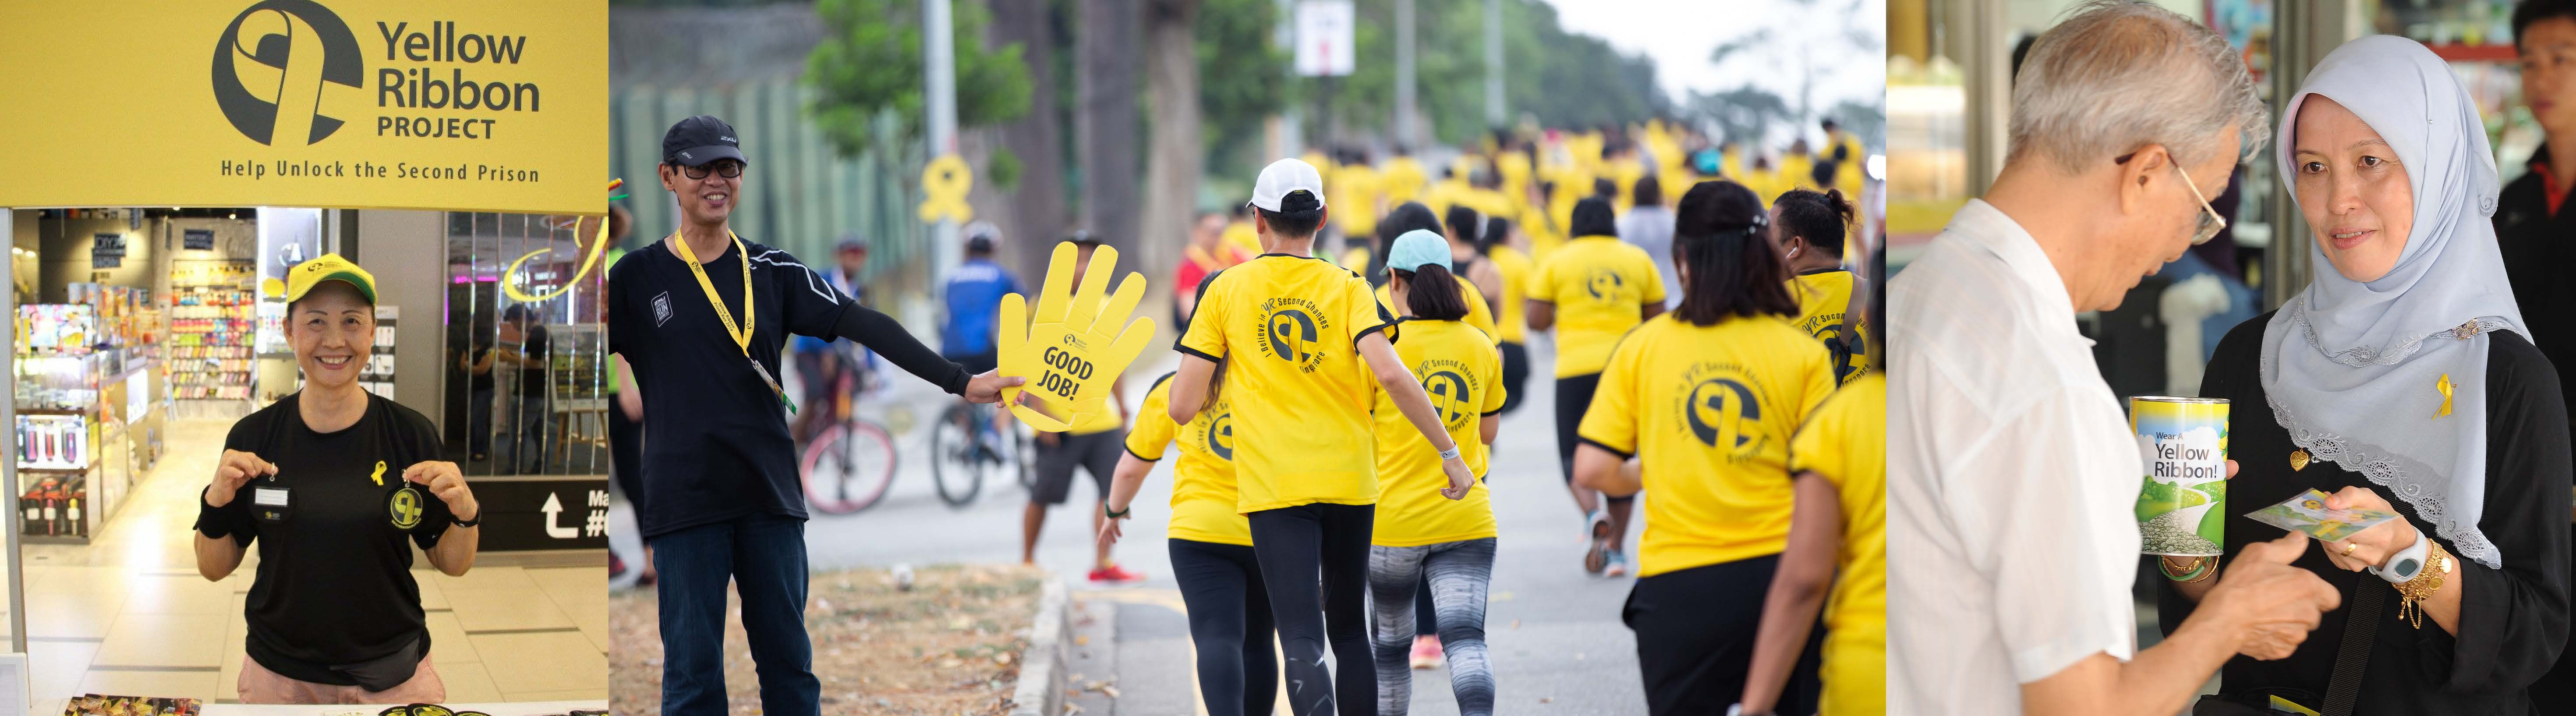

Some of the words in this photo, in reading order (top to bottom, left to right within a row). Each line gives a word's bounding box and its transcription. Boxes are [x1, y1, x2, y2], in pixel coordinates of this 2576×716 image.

[377, 21, 526, 64] Yellow
[378, 67, 540, 112] Ribbon
[378, 116, 496, 139] PROJECT
[221, 160, 265, 180] Help
[277, 161, 344, 177] Unlock
[355, 162, 386, 178] the
[398, 163, 467, 180] Second
[478, 164, 539, 183] Prison
[654, 296, 666, 306] 2XU
[656, 303, 669, 318] RUN
[1261, 298, 1277, 316] YR
[1277, 298, 1306, 306] Second
[718, 302, 726, 314] Yellow
[726, 315, 735, 329] Ribbon
[1306, 301, 1329, 329] Chances
[1802, 316, 1821, 335] YR
[1820, 313, 1845, 323] Secon
[1256, 324, 1269, 352] Believe
[1044, 346, 1093, 380] GOOD
[1037, 369, 1080, 401] JOB!
[1415, 361, 1430, 379] YR
[1432, 359, 1458, 368] Second
[1460, 363, 1479, 391] Chances
[2156, 432, 2176, 440] Wear
[2155, 443, 2210, 461] Yellow
[2155, 461, 2217, 479] Ribbon!
